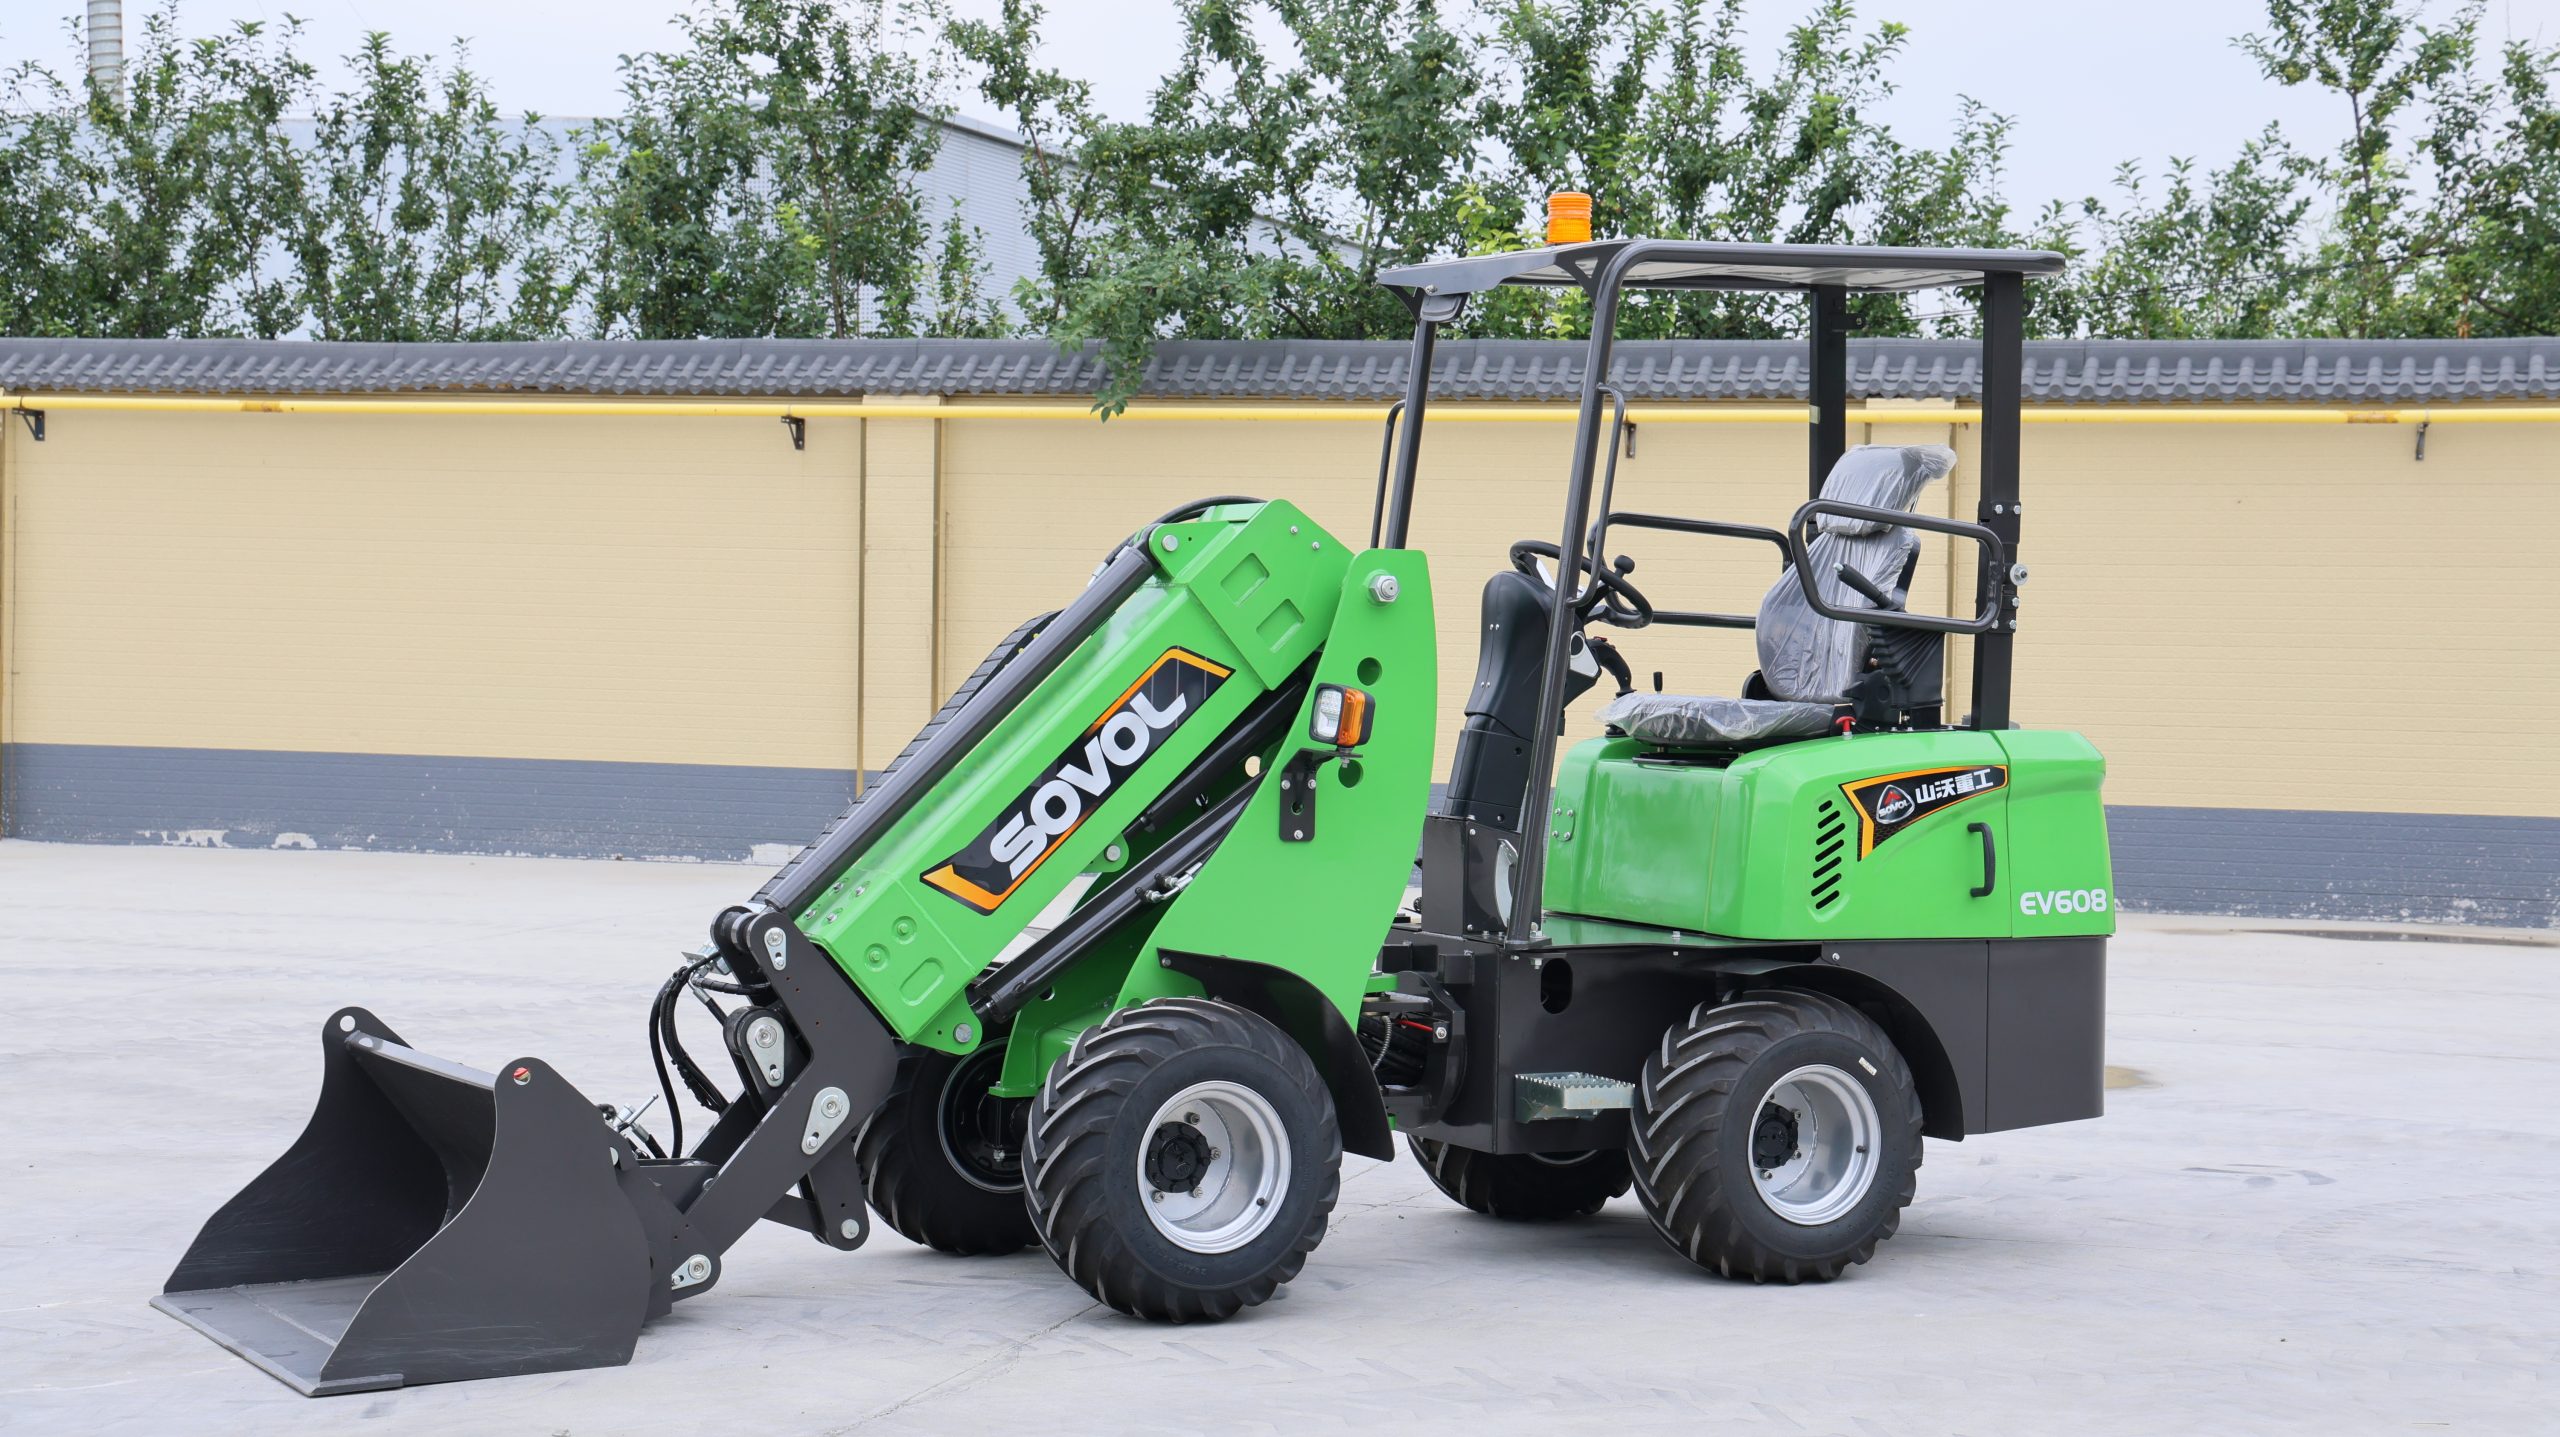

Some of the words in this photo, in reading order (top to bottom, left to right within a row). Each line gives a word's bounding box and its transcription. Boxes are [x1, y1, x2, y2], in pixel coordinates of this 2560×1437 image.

[990, 691, 1187, 881] SOVOL
[1915, 768, 1994, 804] 山沃重工
[1878, 799, 1910, 817] SOVOL
[2020, 888, 2107, 916] EV608
